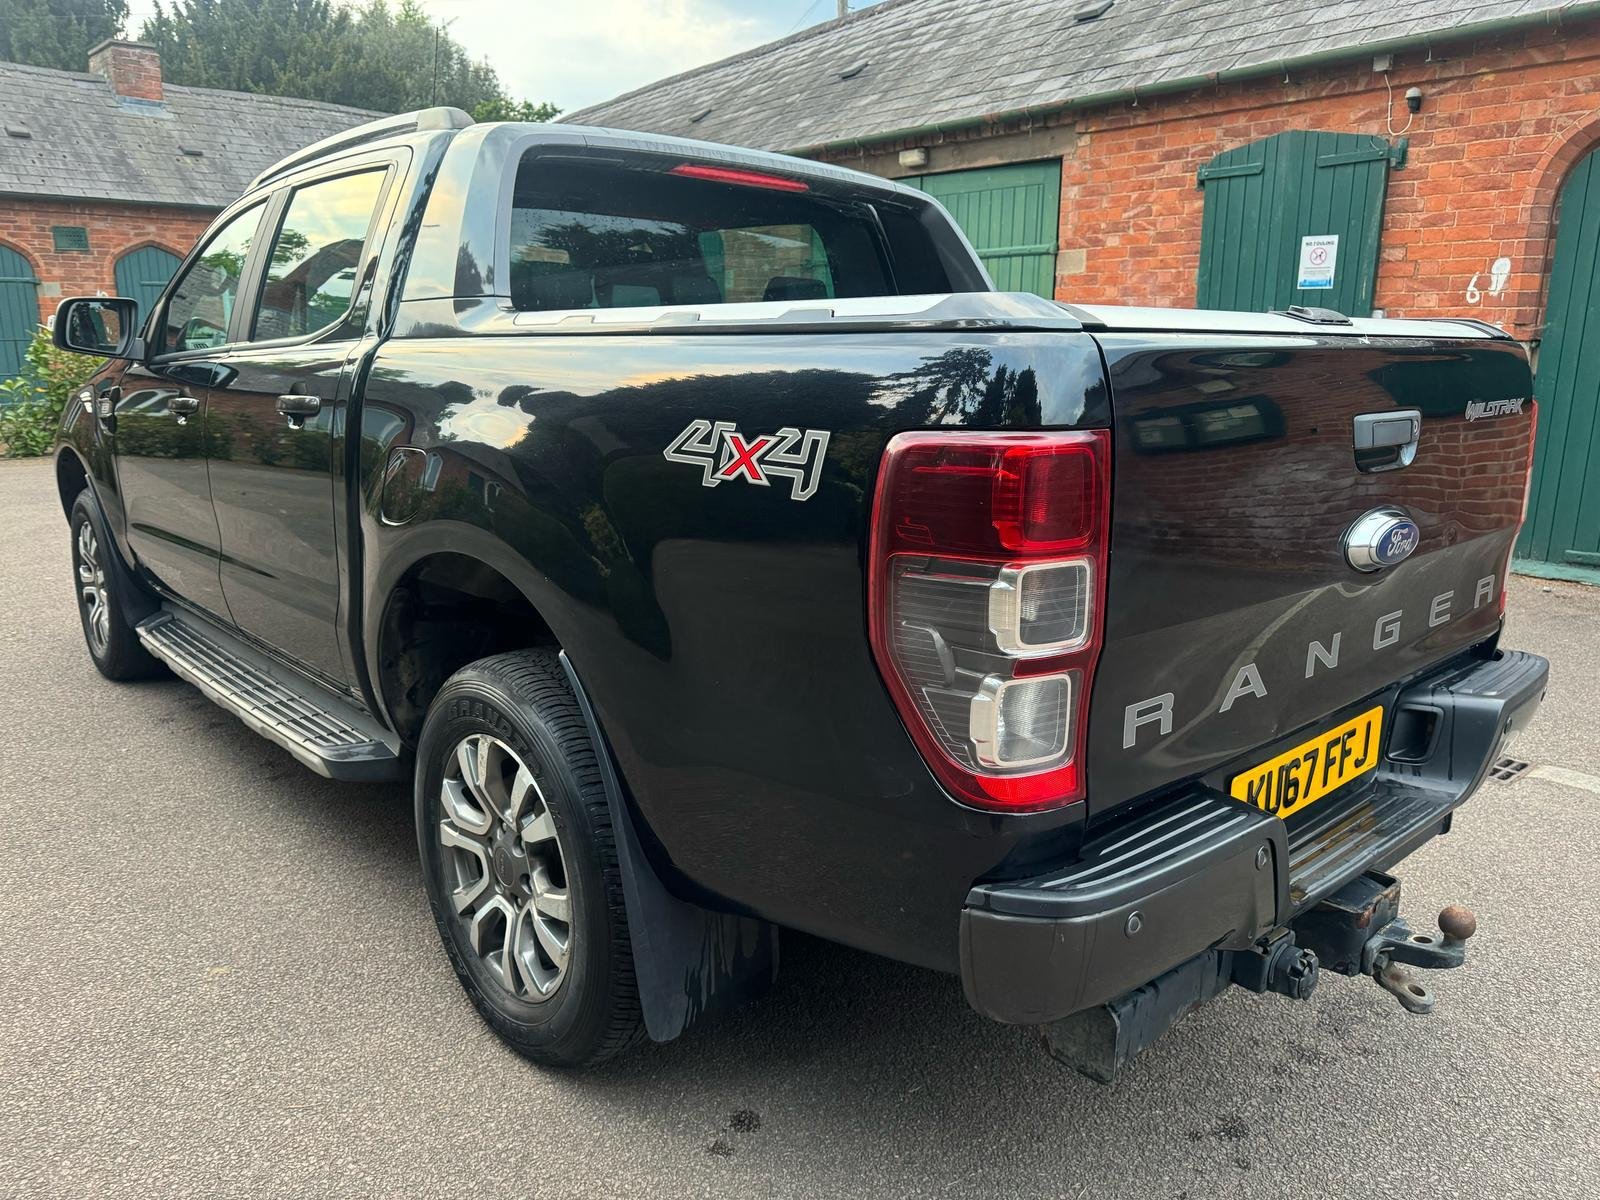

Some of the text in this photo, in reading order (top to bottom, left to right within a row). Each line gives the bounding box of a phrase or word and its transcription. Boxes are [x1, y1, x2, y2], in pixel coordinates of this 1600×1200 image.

[1466, 270, 1480, 304] 6
[1465, 398, 1524, 422] WILDTRAK
[1387, 527, 1414, 556] Ford
[1123, 574, 1496, 749] RANGER
